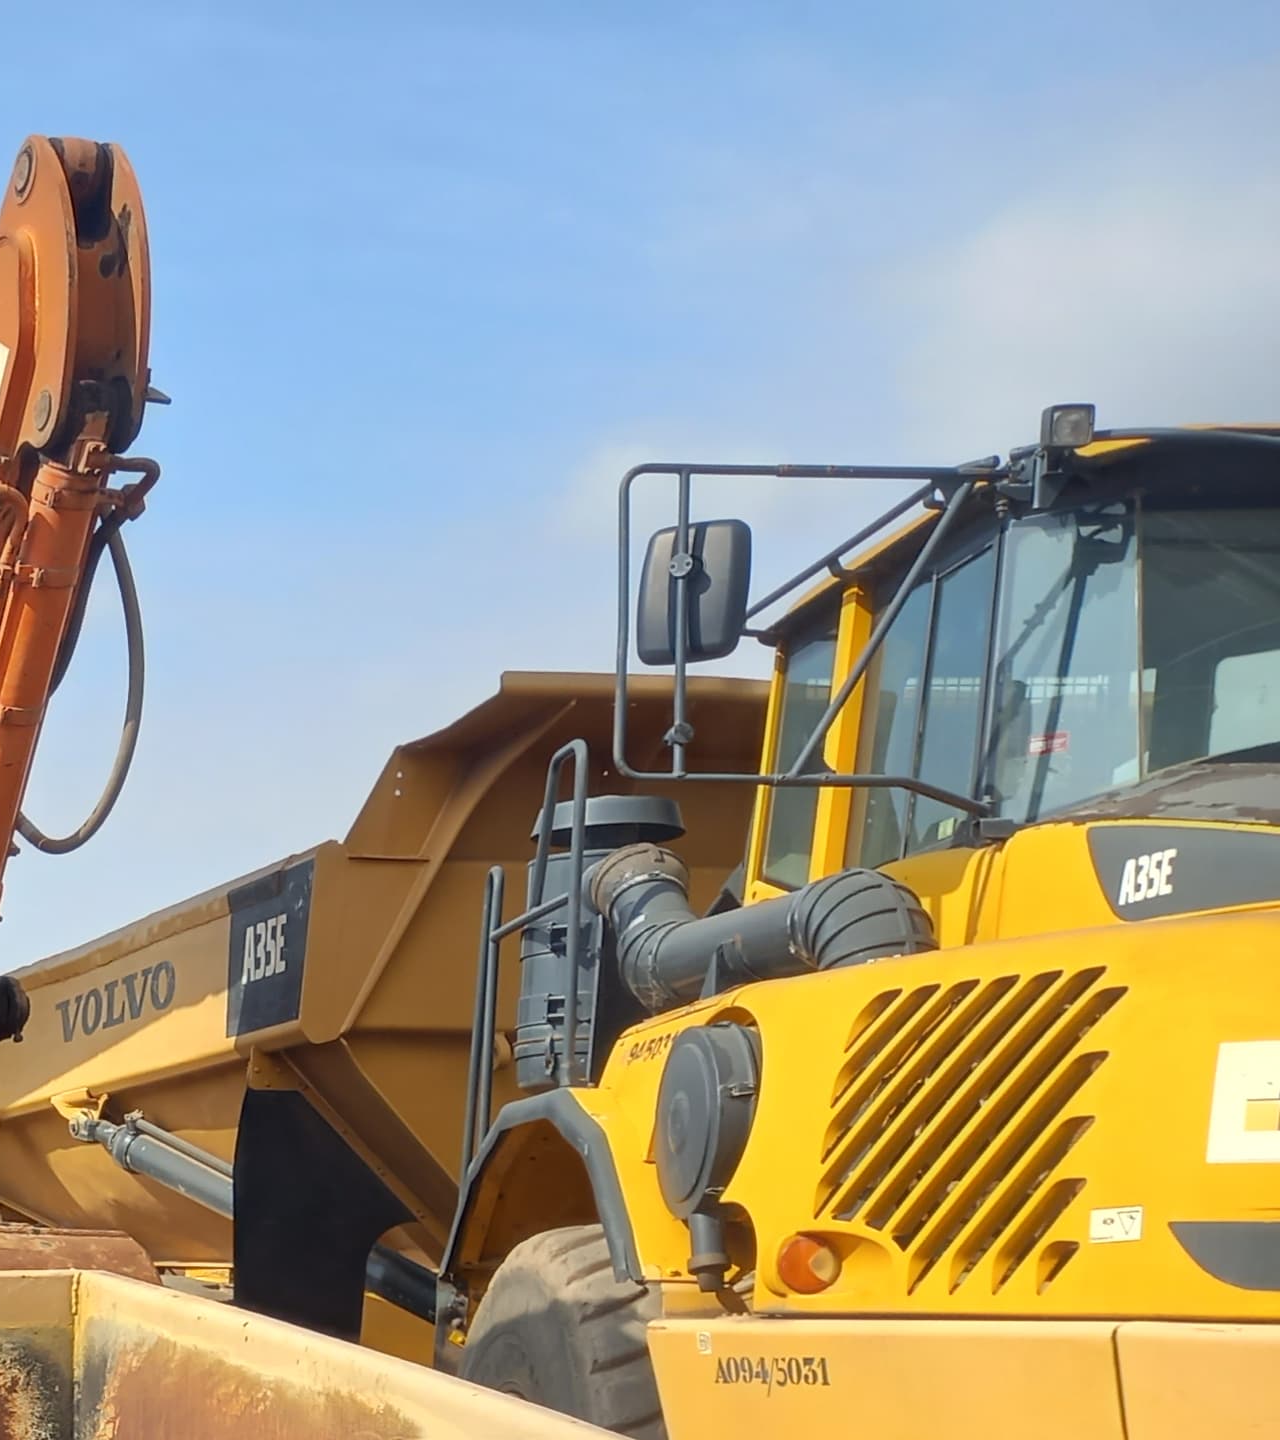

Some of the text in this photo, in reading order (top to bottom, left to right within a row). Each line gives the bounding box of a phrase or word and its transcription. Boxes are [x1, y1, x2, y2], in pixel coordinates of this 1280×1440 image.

[1118, 848, 1178, 906] A35E
[241, 912, 288, 985] A35E
[55, 960, 176, 1043] VOLVO
[714, 1356, 831, 1398] A094/5031
